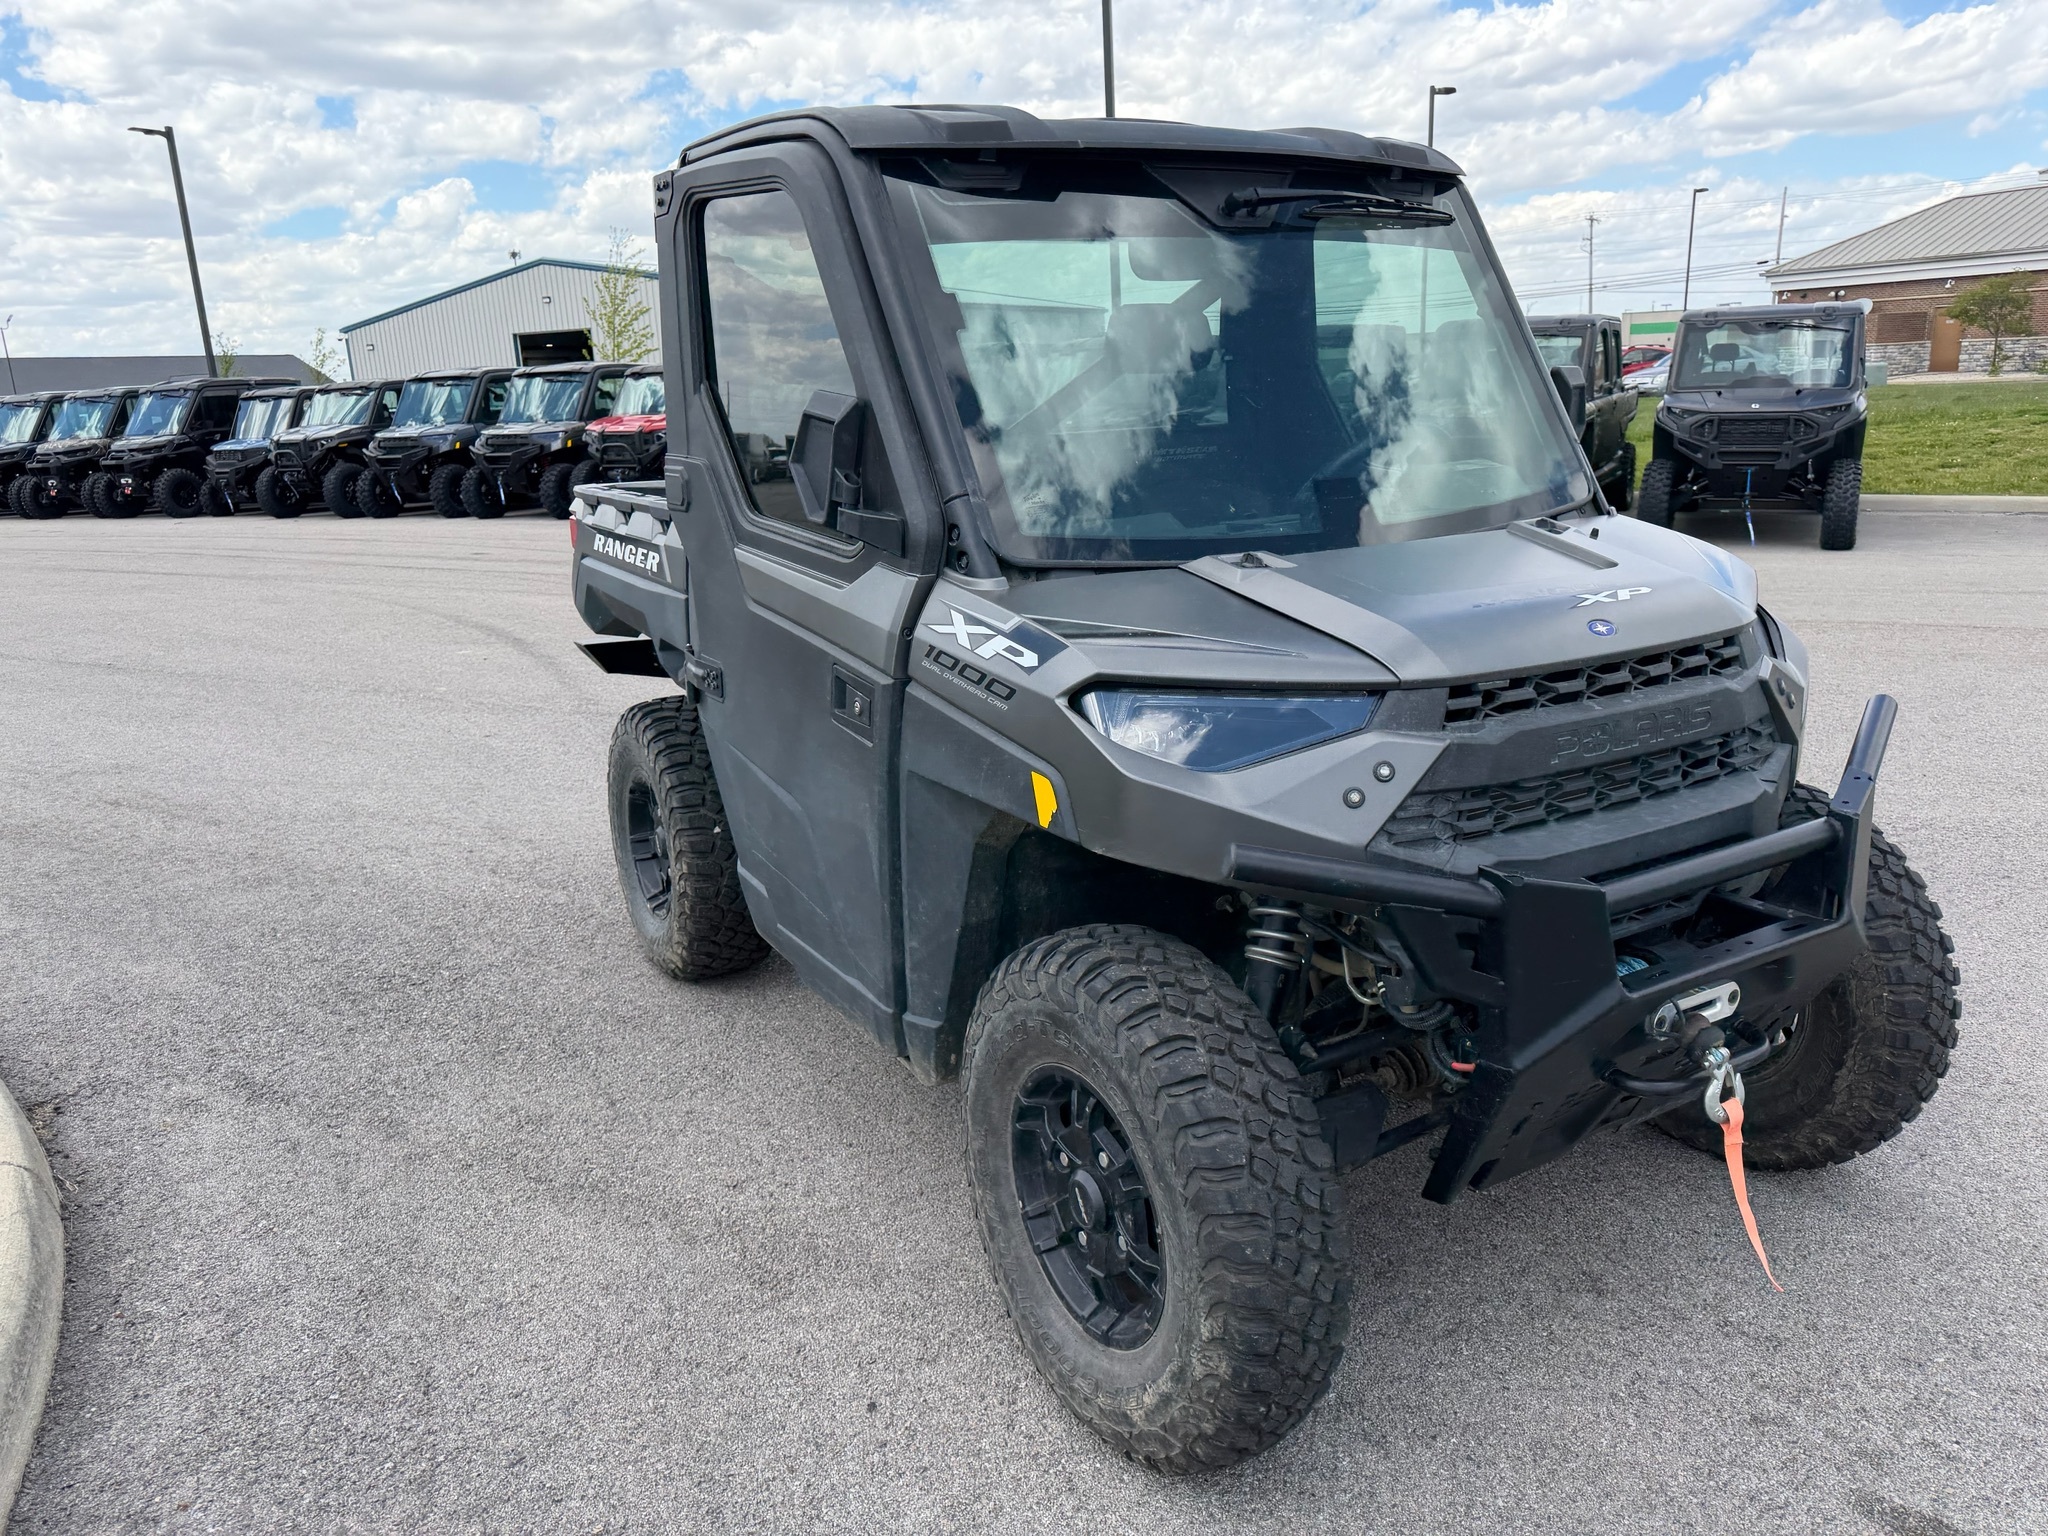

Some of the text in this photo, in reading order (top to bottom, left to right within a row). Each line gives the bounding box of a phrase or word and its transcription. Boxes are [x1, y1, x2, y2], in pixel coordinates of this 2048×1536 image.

[593, 533, 660, 573] RANGER
[1575, 586, 1653, 608] XP
[926, 608, 1039, 668] XP
[920, 660, 1009, 711] DUAL OVERHEAD CAM
[923, 644, 1017, 701] 1000
[1550, 704, 1713, 764] POLARIS
